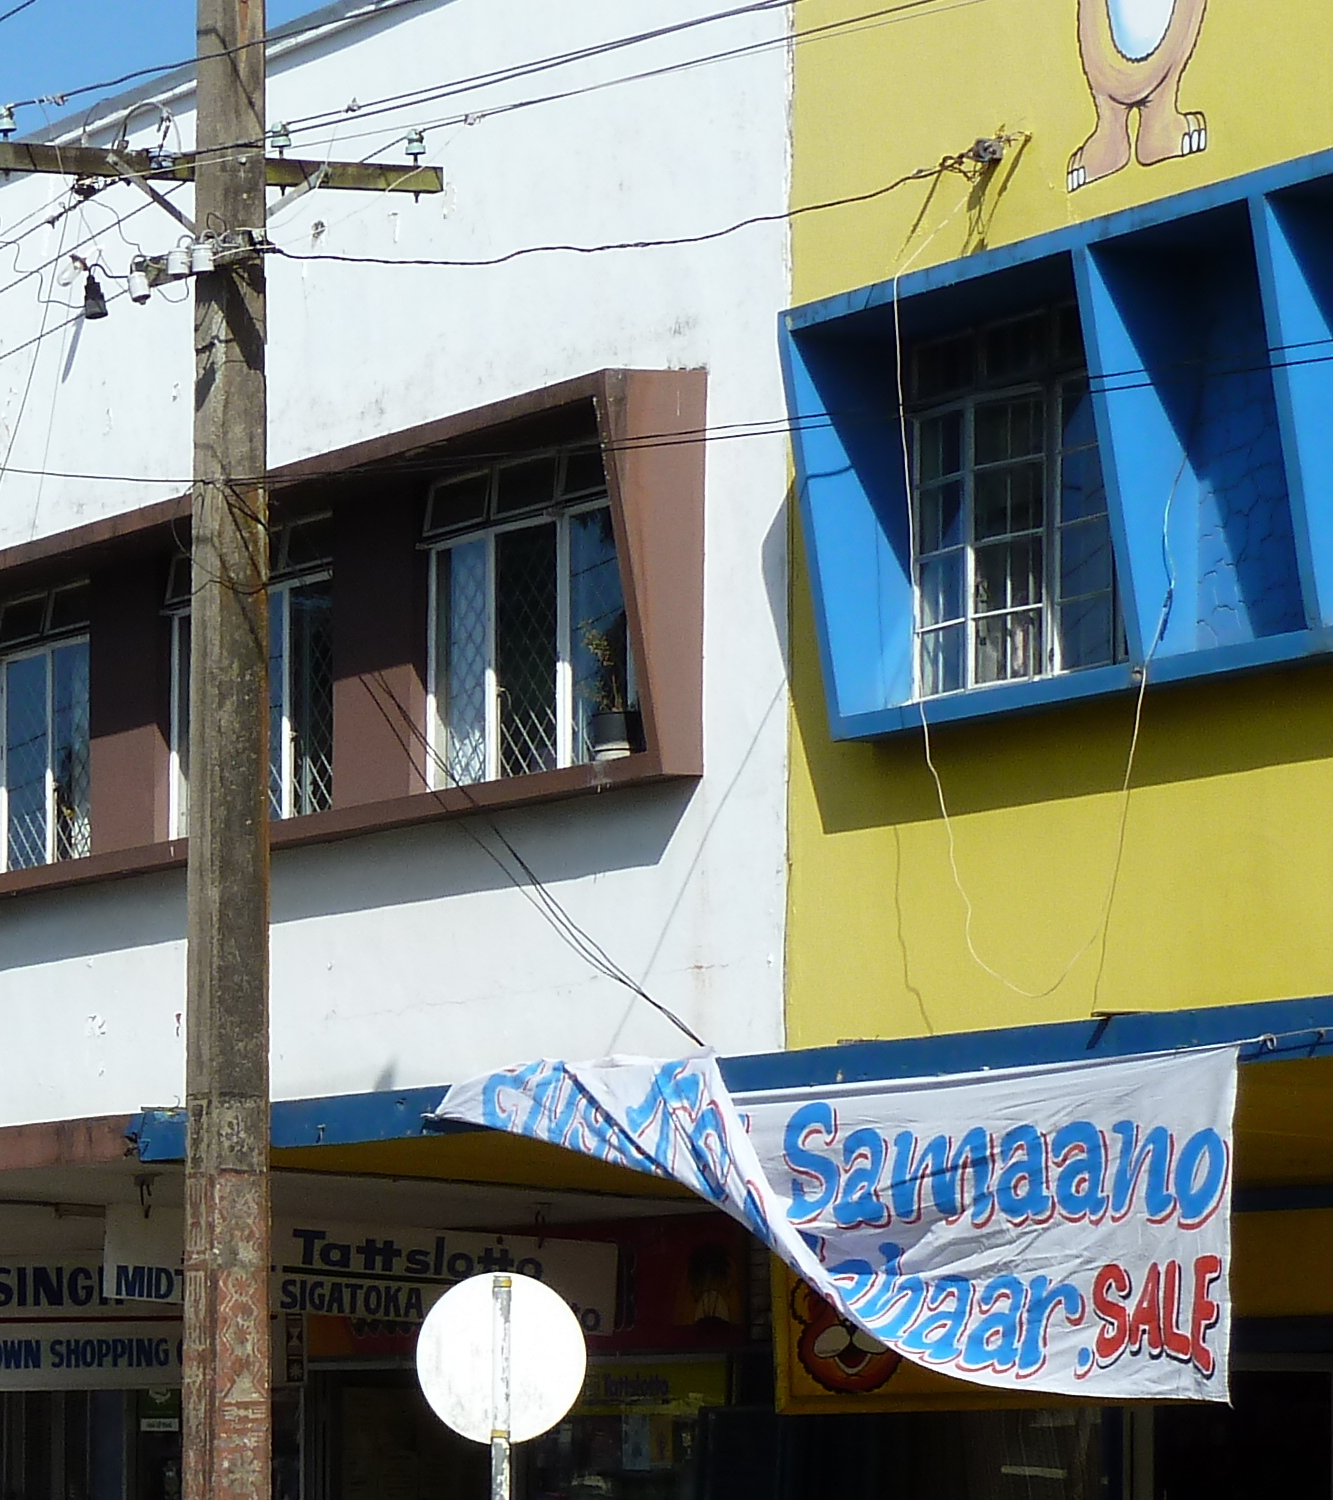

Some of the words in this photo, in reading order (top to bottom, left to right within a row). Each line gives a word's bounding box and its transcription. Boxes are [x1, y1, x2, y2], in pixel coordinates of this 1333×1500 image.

[784, 1101, 1228, 1231] Samaano
[293, 1228, 544, 1280] Tattslotto
[280, 1278, 424, 1319] SIGATOKA
[801, 1238, 1094, 1379] ahaar.
[1093, 1254, 1221, 1379] SALE
[51, 1338, 170, 1369] SHOPPING
